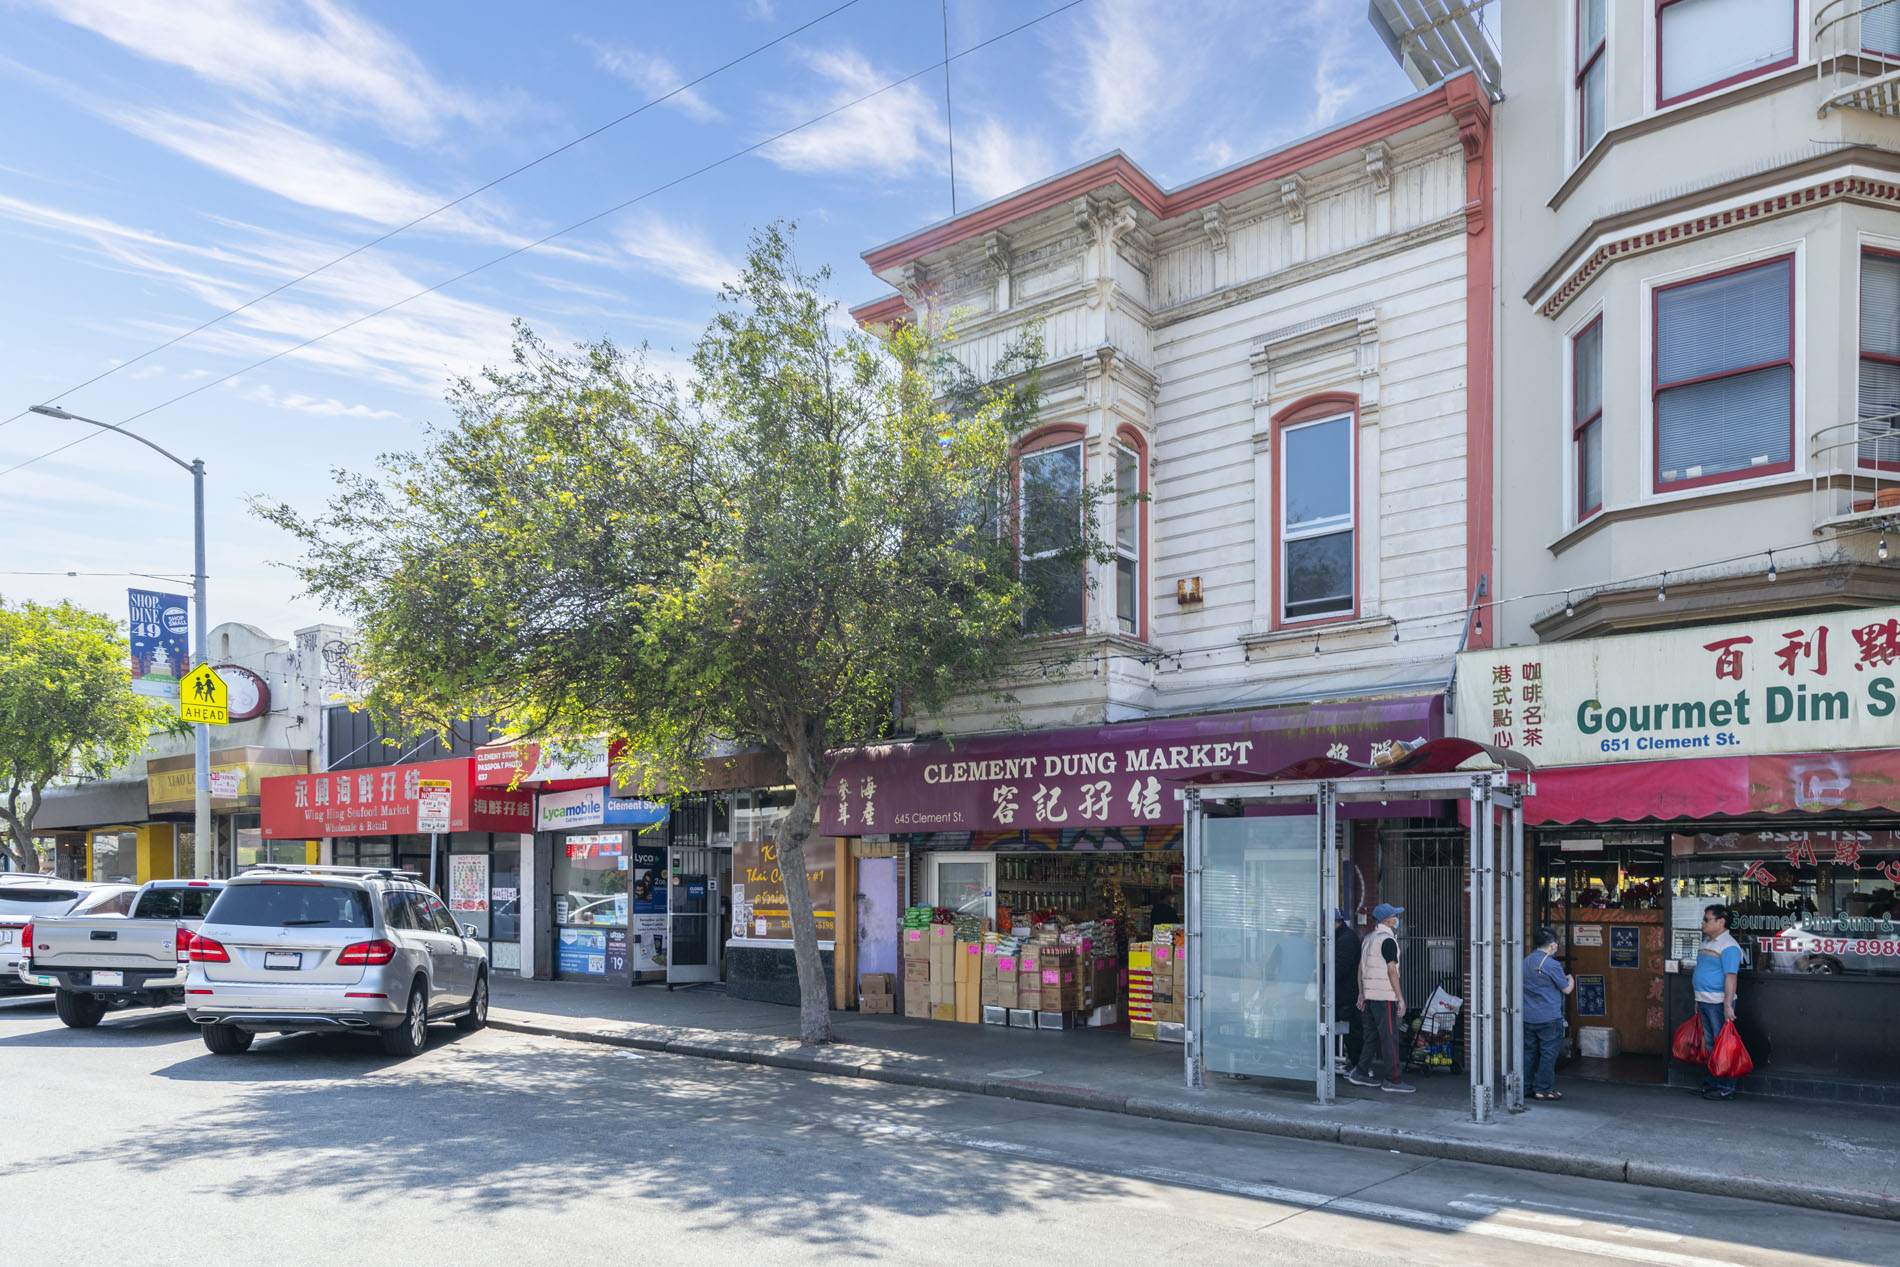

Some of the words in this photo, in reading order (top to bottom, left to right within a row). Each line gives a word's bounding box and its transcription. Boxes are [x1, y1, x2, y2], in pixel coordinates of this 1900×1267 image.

[131, 593, 159, 609] SHOP
[131, 606, 160, 624] DINE
[131, 622, 161, 638] 49
[1492, 664, 1514, 749] 港式點心
[1522, 662, 1543, 747] 咖啡名茶
[1576, 688, 1750, 735] Gourmet
[1766, 683, 1849, 724] Dim
[185, 707, 224, 721] AHEAD
[1600, 737, 1630, 753] 651
[1636, 733, 1709, 751] Clement
[1715, 731, 1740, 746] St.
[477, 752, 501, 761] CLEMENT
[924, 757, 1037, 784] CLEMENT
[1043, 752, 1117, 777] DUNG
[1125, 741, 1253, 772] MARKET
[477, 762, 503, 771] PASSPORT
[304, 809, 324, 822] Wing
[347, 806, 378, 818] Seafood
[381, 804, 410, 816] Market
[543, 801, 600, 821] Lycamobile
[608, 800, 642, 810] Clement
[894, 812, 910, 824] 645
[911, 813, 950, 824] Clement
[953, 811, 965, 823] St.
[325, 823, 357, 833] Wholesale
[367, 820, 387, 831] Retail
[634, 853, 654, 863] Lyca
[746, 867, 768, 884] Thai
[1729, 910, 1796, 930] Gourmet
[1801, 911, 1833, 931] Dim
[1838, 912, 1875, 932] Sum
[1880, 911, 1894, 932] &
[1757, 936, 1803, 953] TEL:
